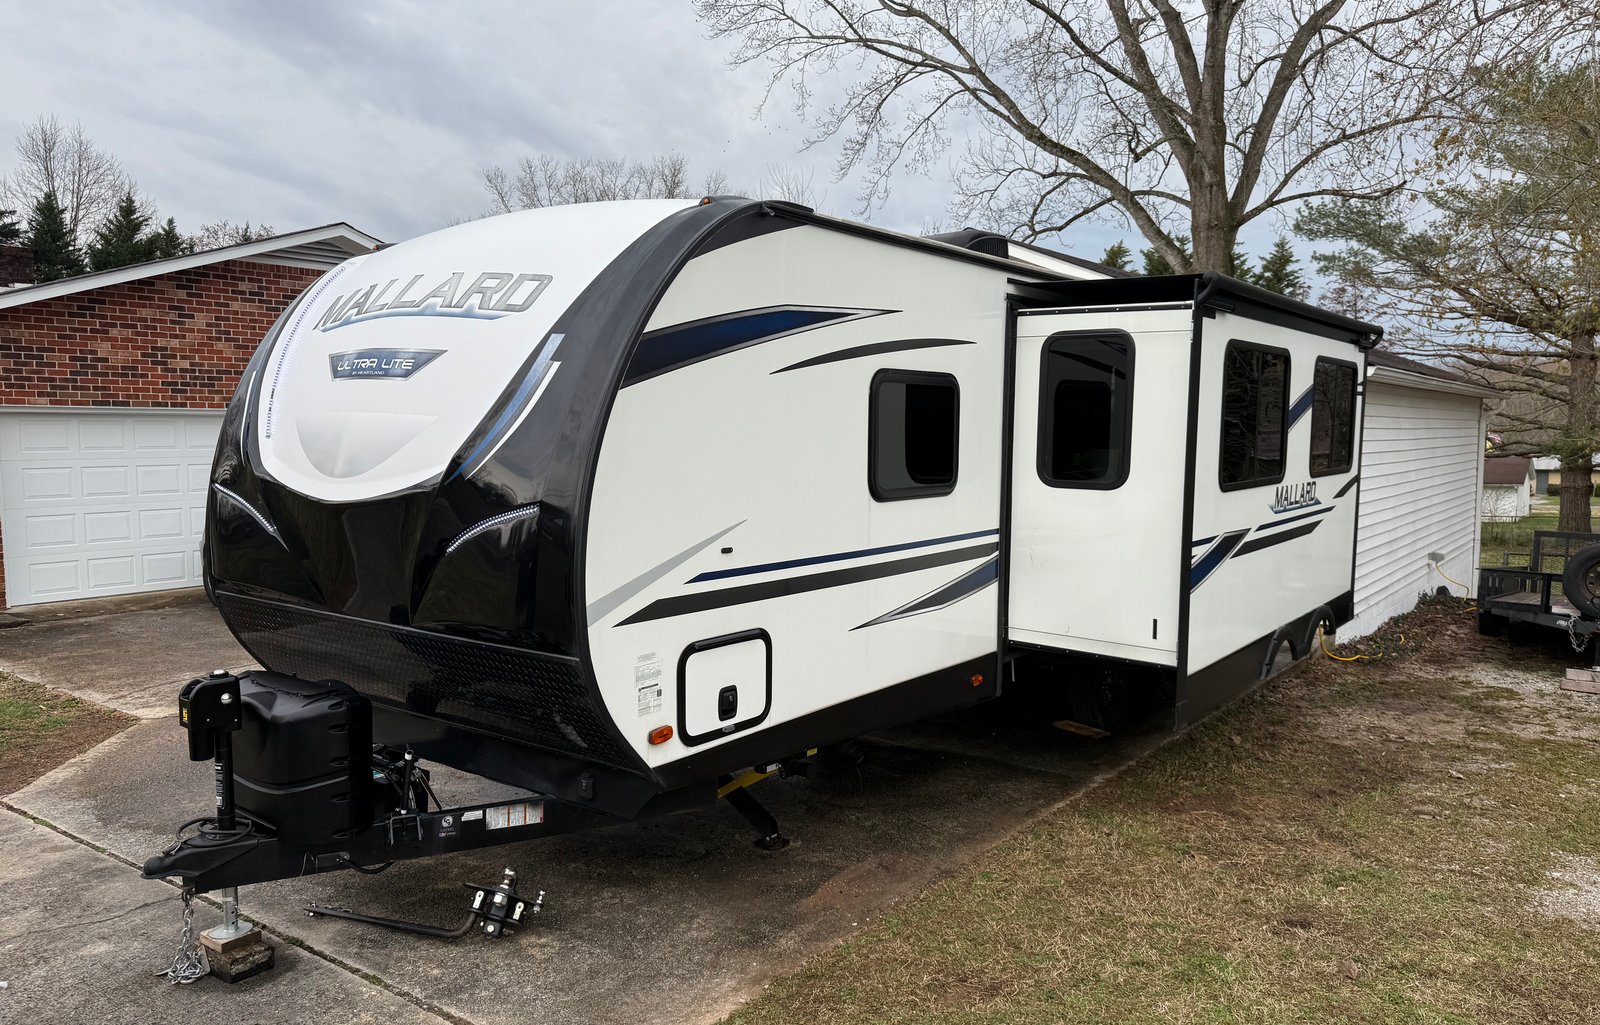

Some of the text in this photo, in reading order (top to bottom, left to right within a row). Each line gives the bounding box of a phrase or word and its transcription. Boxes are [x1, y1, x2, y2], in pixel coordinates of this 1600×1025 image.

[313, 272, 553, 331] MALLARD
[337, 358, 415, 370] ULTRA LITE
[1274, 481, 1317, 510] MALLARD
